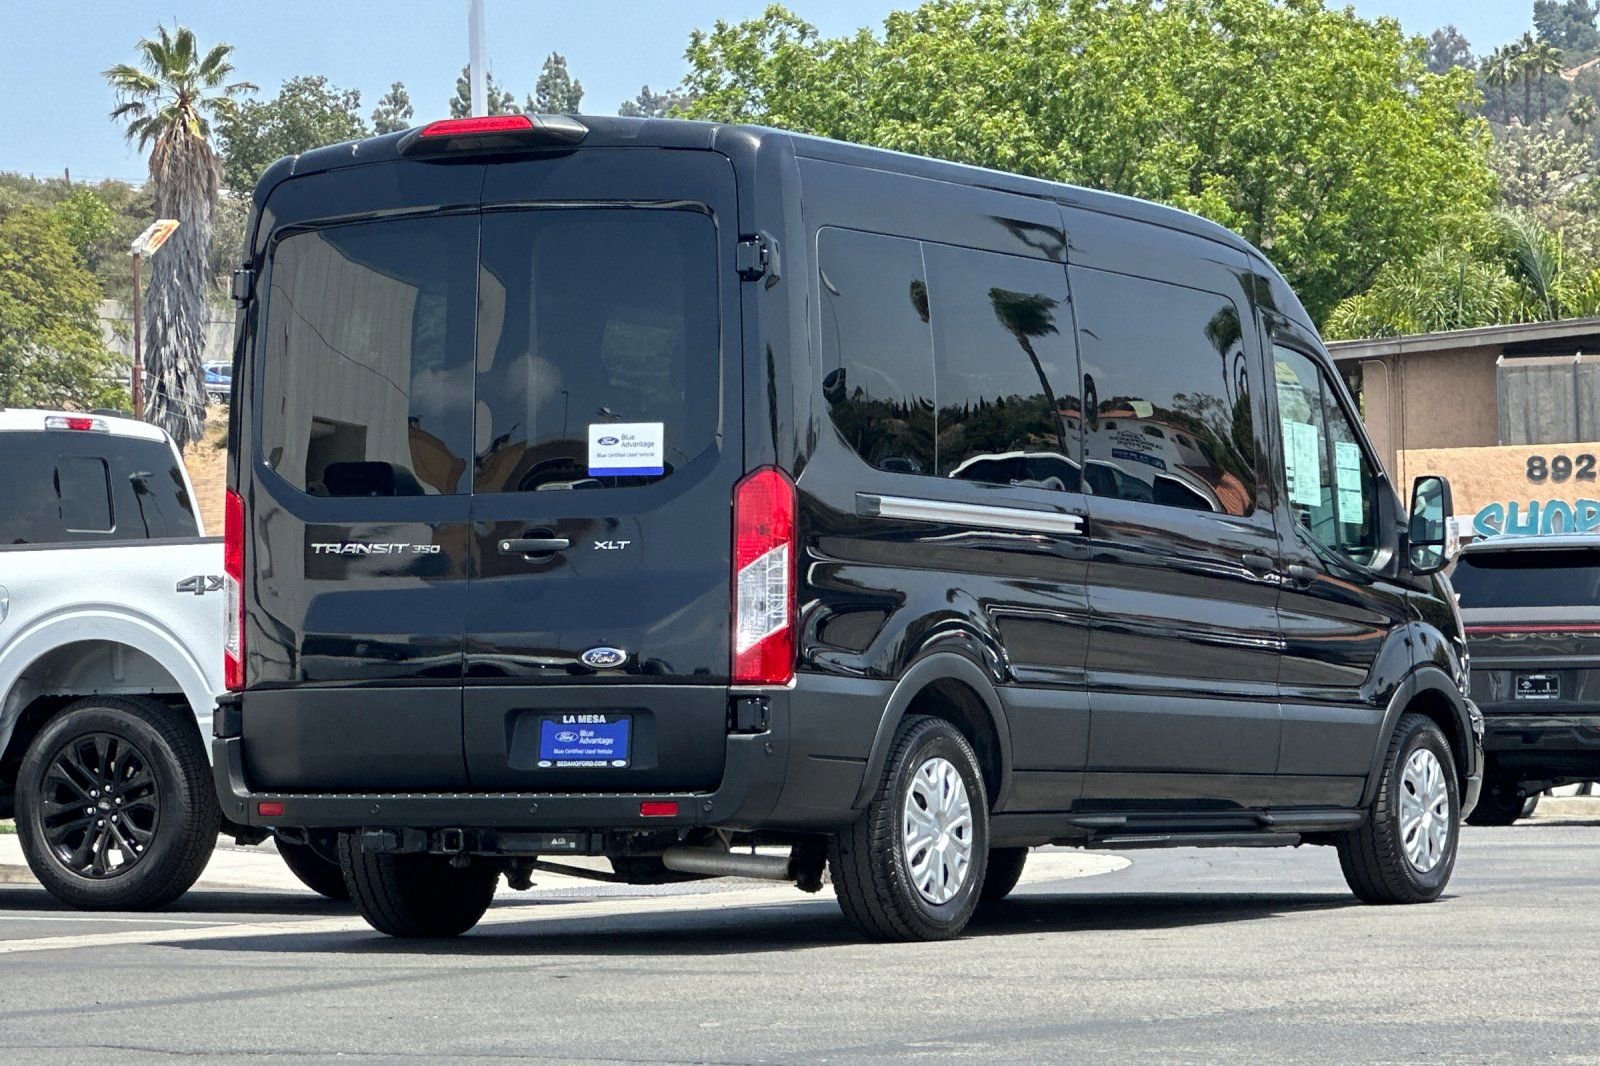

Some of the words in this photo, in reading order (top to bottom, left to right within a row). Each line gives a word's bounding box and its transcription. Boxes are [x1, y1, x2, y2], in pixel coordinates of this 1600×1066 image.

[621, 441, 655, 449] Advantage
[1526, 454, 1597, 482] 892
[311, 543, 410, 554] TRANSIT
[411, 544, 441, 553] 350
[594, 540, 631, 550] XLT
[563, 714, 576, 724] LA
[578, 714, 606, 724] MESA
[579, 737, 614, 745] Advantage
